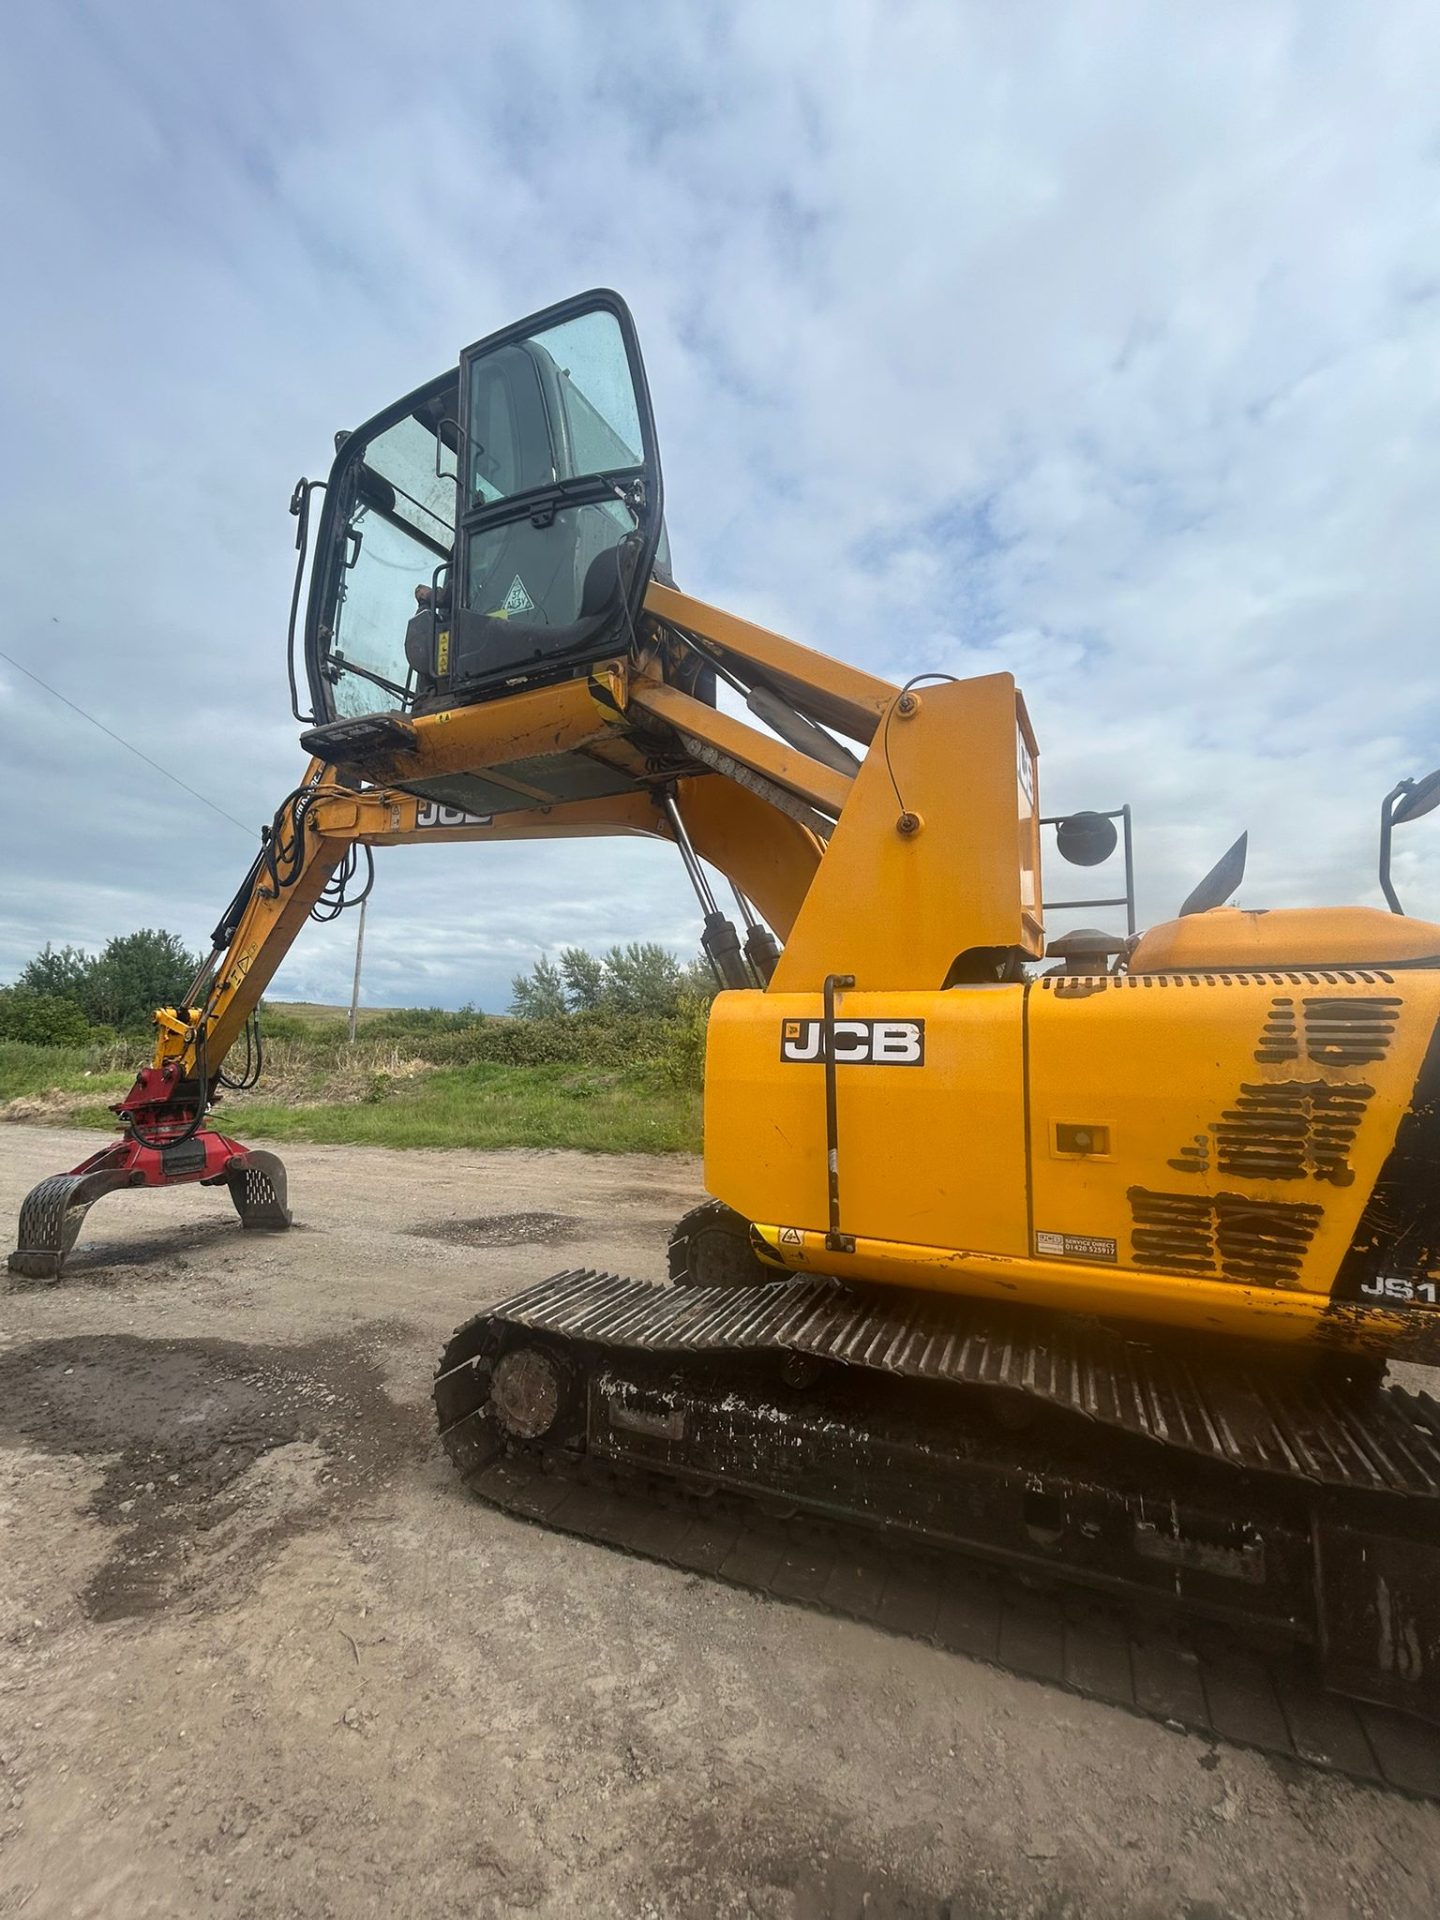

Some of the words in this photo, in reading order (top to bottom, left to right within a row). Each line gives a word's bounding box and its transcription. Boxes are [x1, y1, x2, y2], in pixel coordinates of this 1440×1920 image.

[784, 1022, 921, 1062] JCB
[1065, 1238, 1091, 1247] SERVICE
[1091, 1241, 1115, 1249] DIRECT
